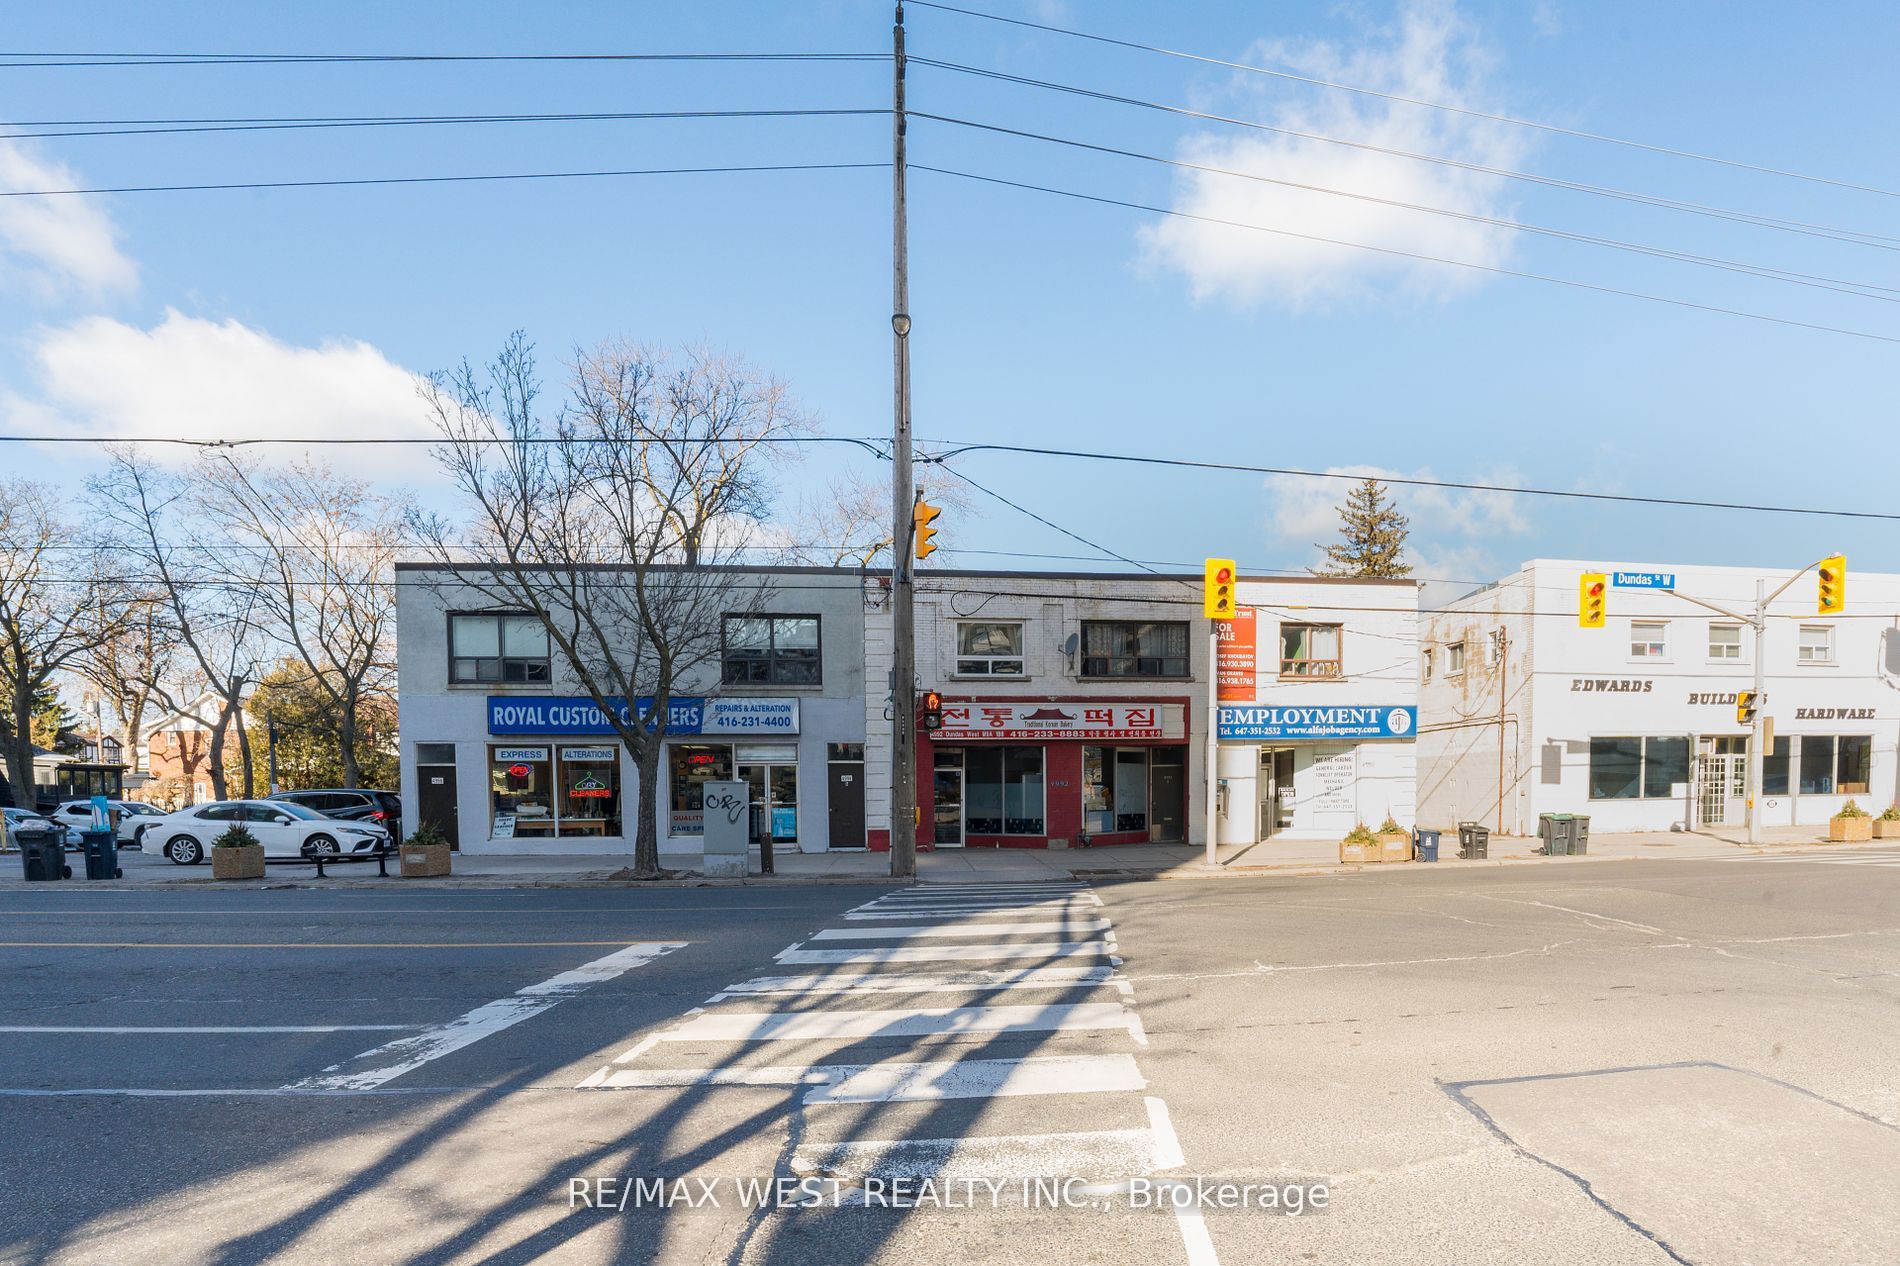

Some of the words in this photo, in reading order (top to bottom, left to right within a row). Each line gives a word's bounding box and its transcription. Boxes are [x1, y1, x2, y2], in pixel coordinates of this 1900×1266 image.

[1618, 573, 1652, 585] Dundas
[1662, 575, 1671, 586] W
[1571, 680, 1652, 692] EDWARDS
[1688, 693, 1768, 705] BUILD
[494, 706, 545, 725] ROYAL
[621, 706, 698, 726] CEERS
[1219, 708, 1381, 725] EMPLOYMENT
[1795, 708, 1875, 720] HARDWARE
[718, 716, 791, 727] 416-231-4400
[1220, 727, 1232, 735] Tel.
[1235, 727, 1281, 735] 647-351-2532
[1286, 725, 1381, 736] www.alfajobagency.com
[501, 750, 542, 759] EXPRESS
[564, 750, 613, 759] ALTERATIONS
[569, 790, 611, 798] CLEANERS
